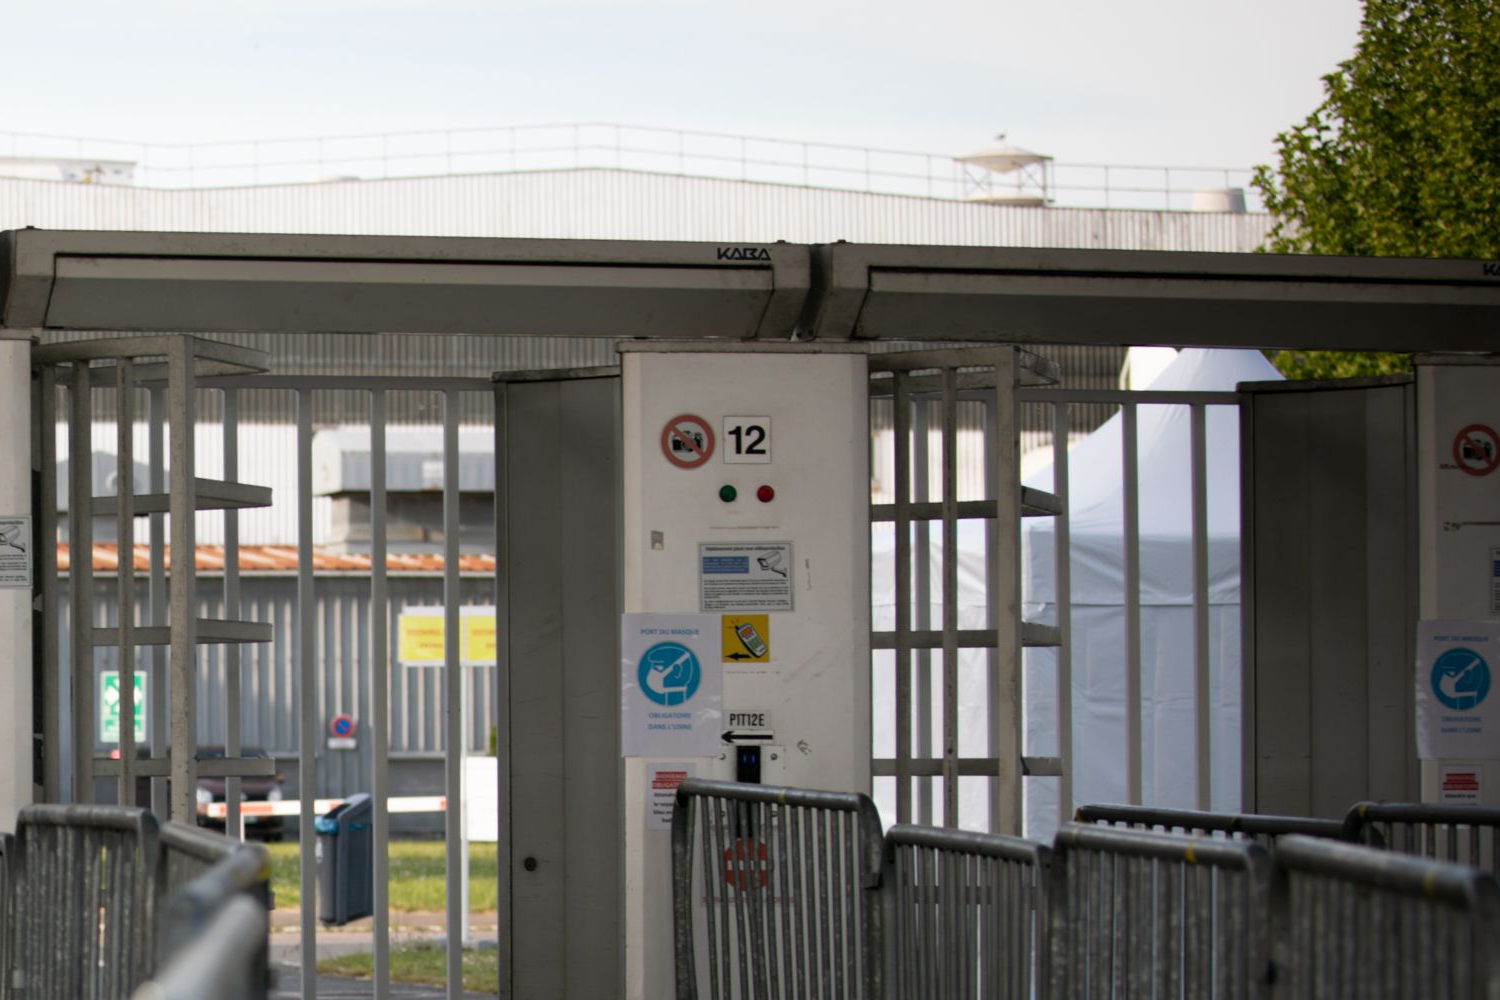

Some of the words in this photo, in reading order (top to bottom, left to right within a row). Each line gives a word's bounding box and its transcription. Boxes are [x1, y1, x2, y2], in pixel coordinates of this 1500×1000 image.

[717, 247, 772, 261] KABA
[727, 425, 767, 455] 12
[729, 713, 765, 727] P1T12E
